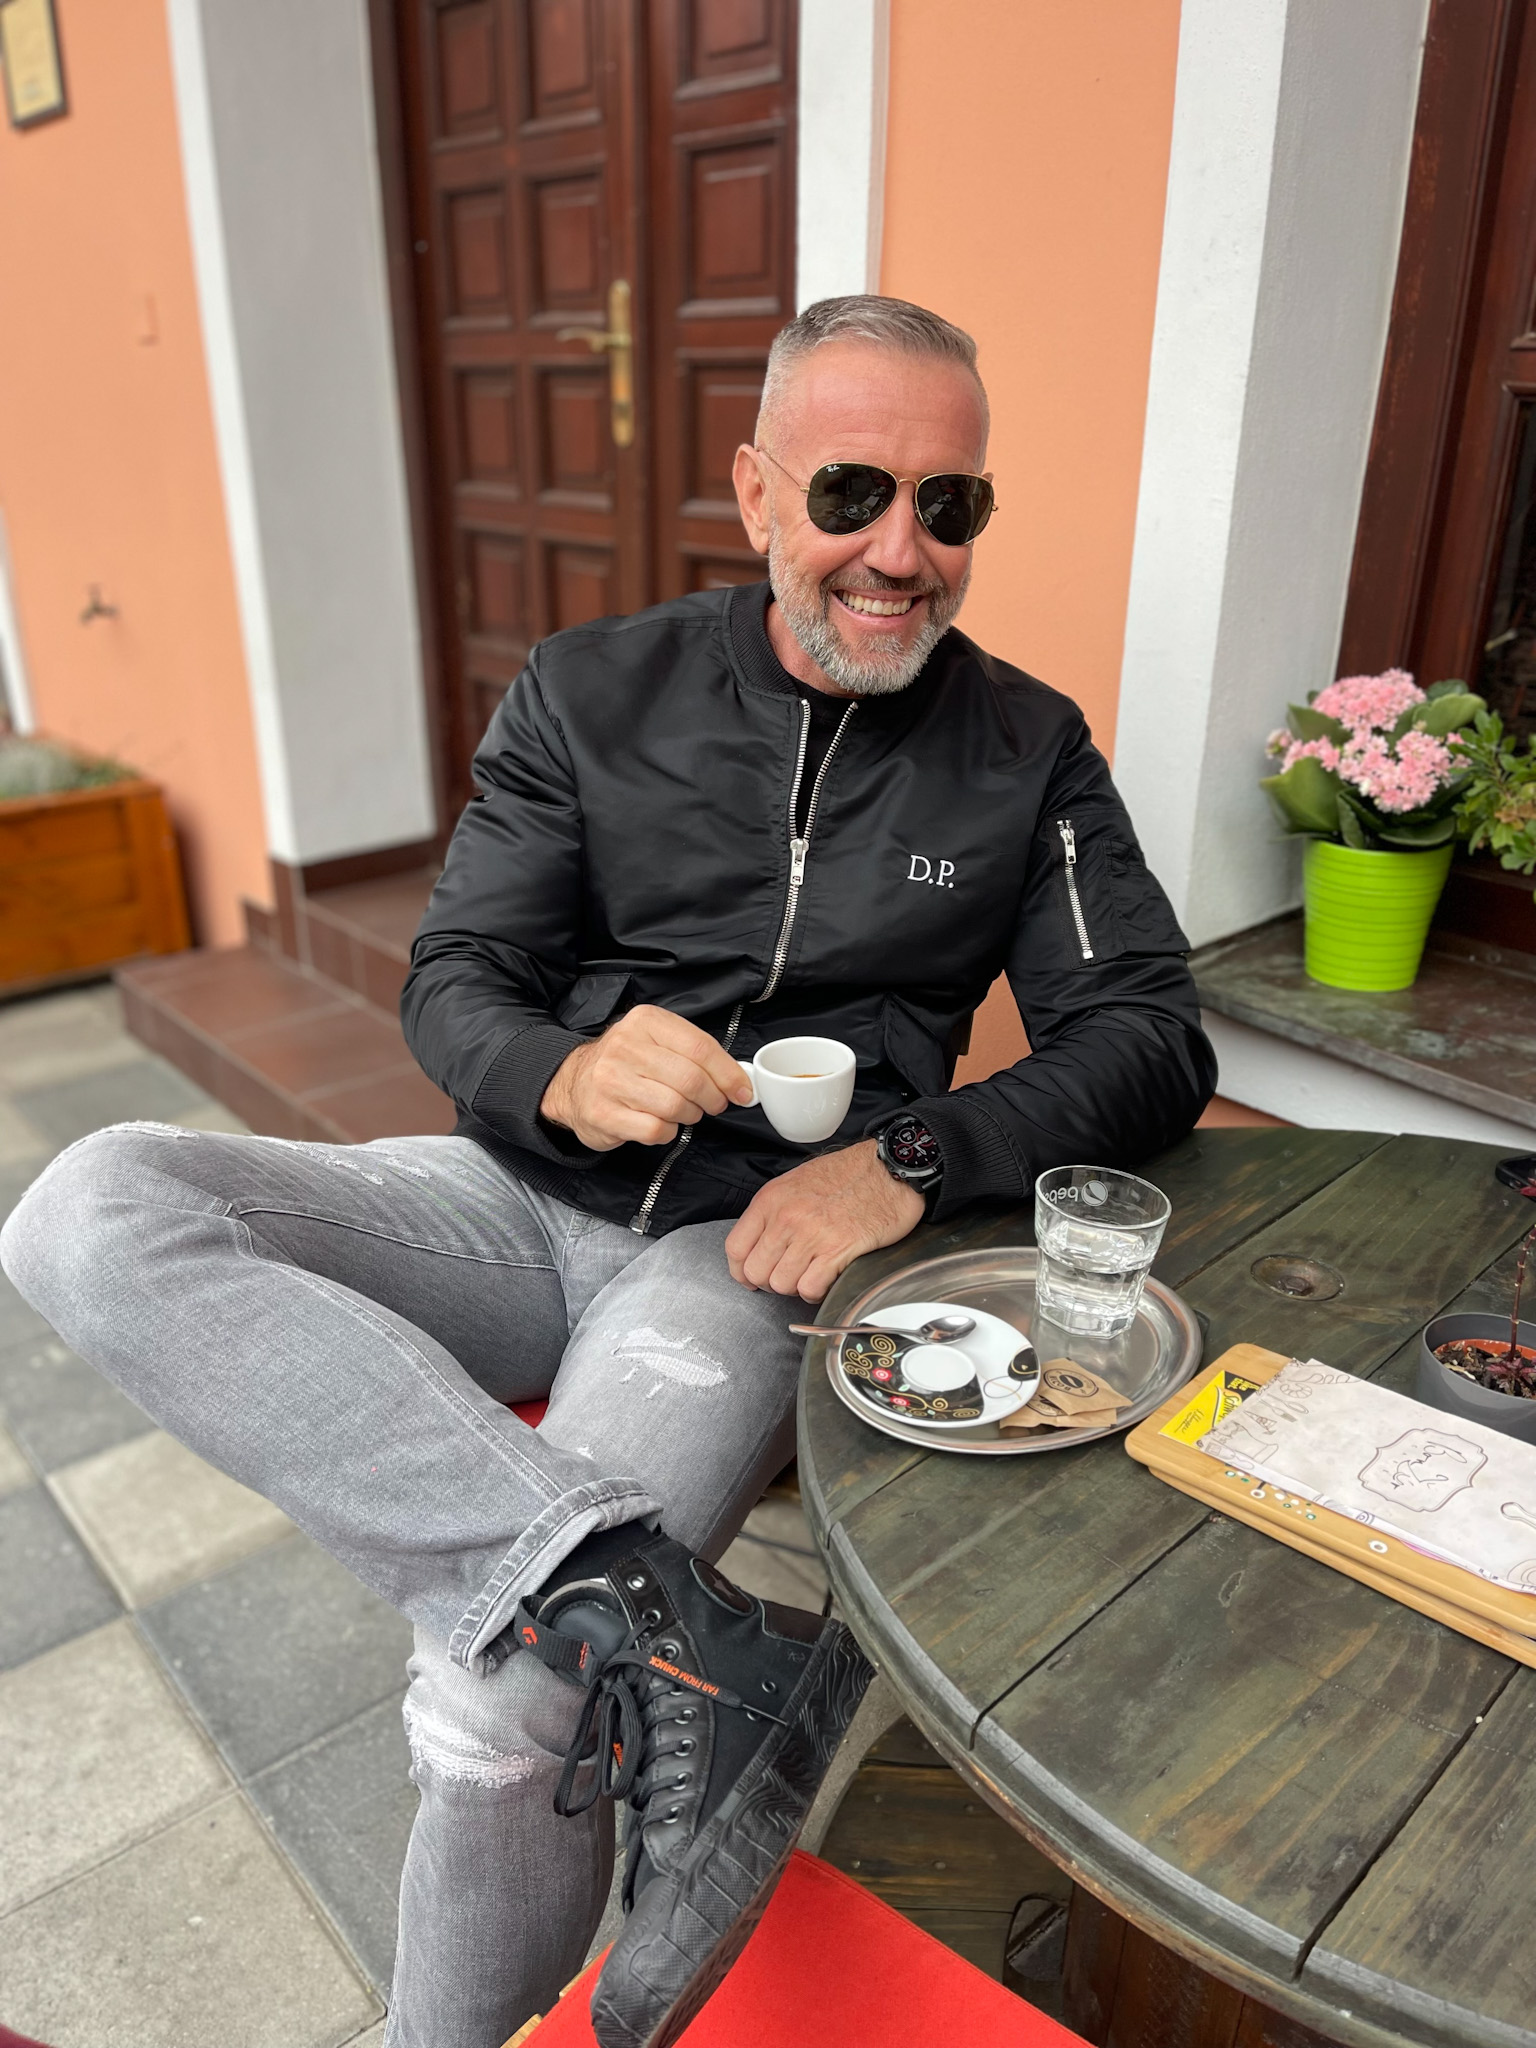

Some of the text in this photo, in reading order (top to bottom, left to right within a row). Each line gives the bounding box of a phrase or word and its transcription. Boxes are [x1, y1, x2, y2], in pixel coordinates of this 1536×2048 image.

[907, 854, 956, 889] D.P.
[648, 1655, 720, 1697] FAR FROM CHUCK
